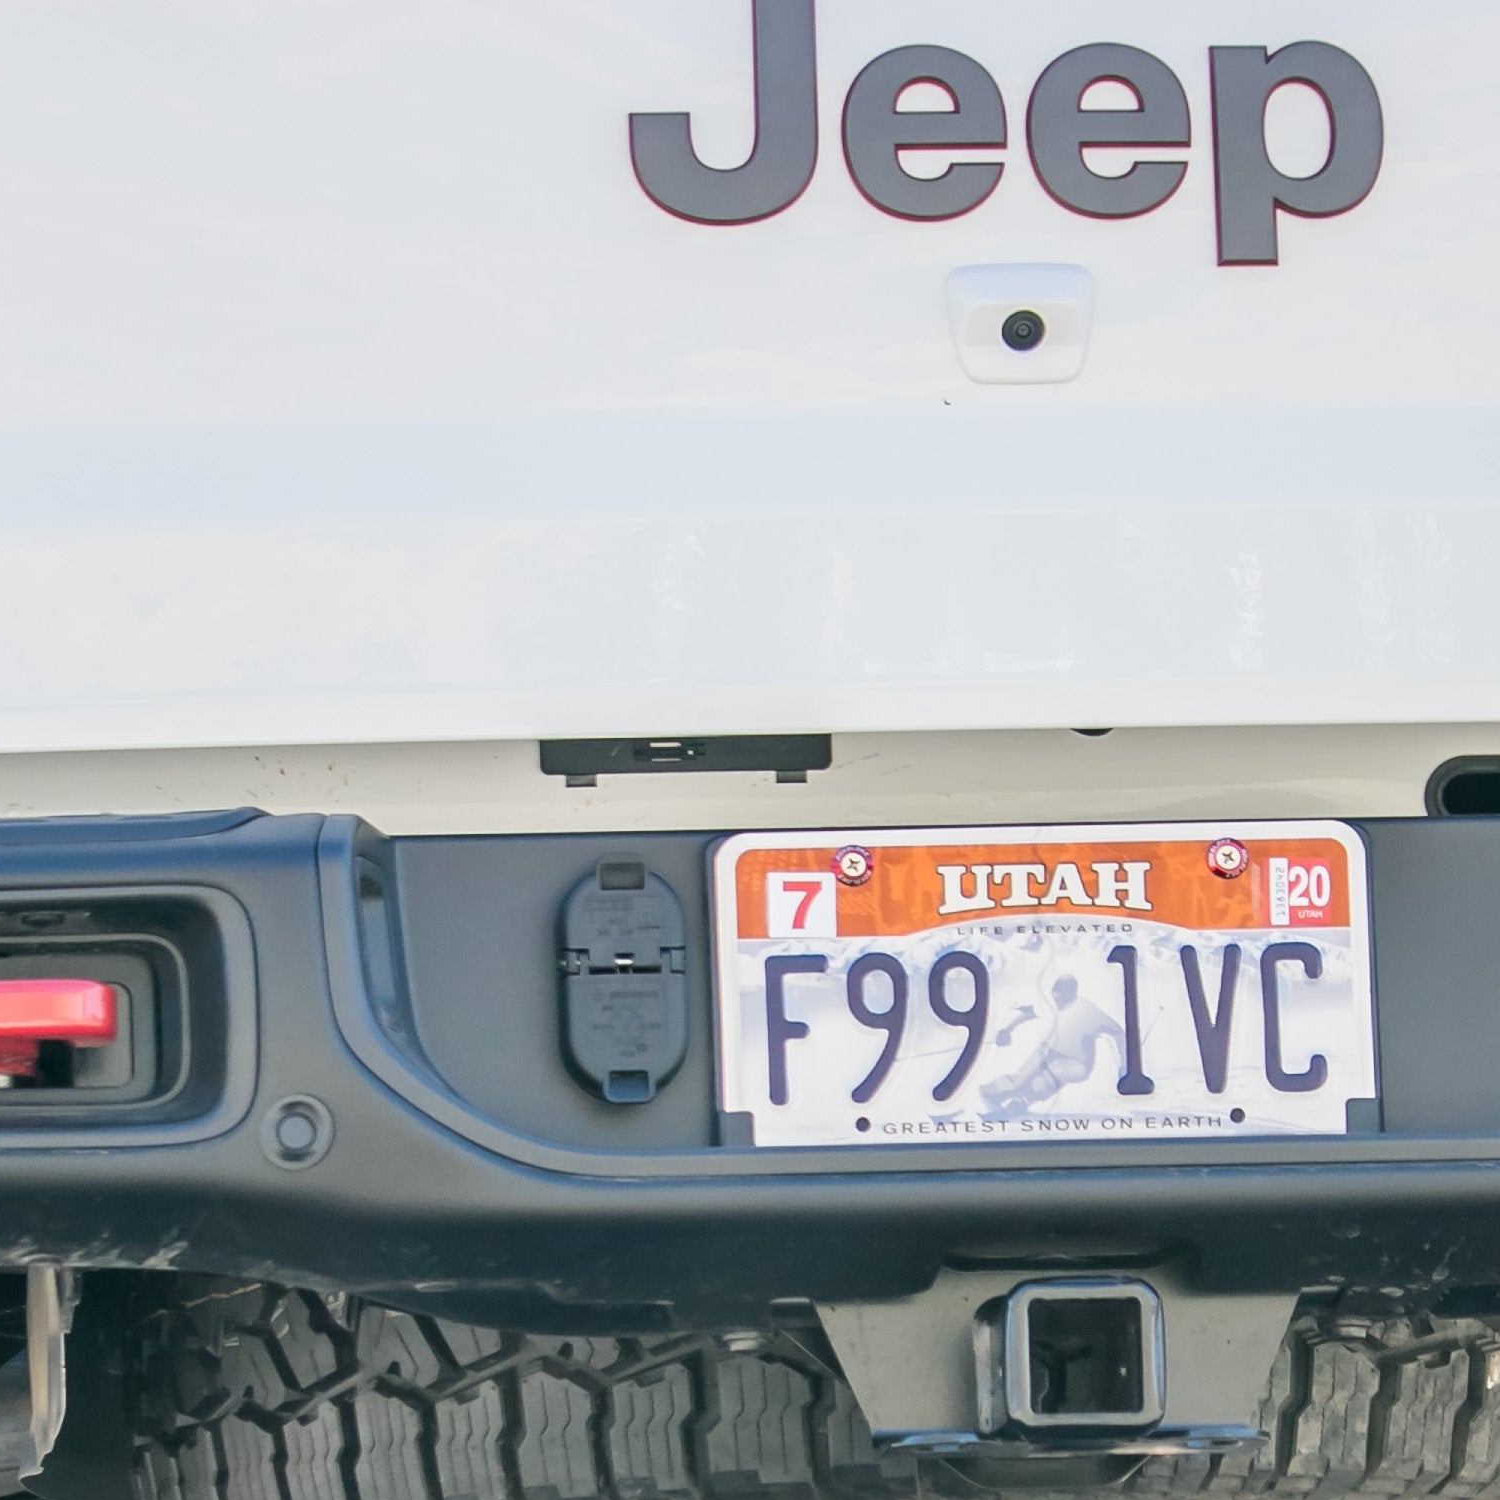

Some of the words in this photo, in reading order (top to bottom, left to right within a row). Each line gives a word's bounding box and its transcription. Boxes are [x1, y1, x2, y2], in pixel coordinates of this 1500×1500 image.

[628, 0, 1385, 267] Jeep
[782, 880, 824, 930] 7
[936, 860, 1153, 915] UTAH
[1288, 864, 1331, 907] 20
[957, 925, 1004, 936] LIFE
[1016, 923, 1134, 935] ELEVATED
[1297, 909, 1324, 919] UTAH
[763, 948, 991, 1106] F99
[1105, 940, 1328, 1096] 1VC
[882, 1120, 1009, 1134] GREATEST
[1021, 1118, 1090, 1132] SNOW
[1101, 1117, 1134, 1130] ON
[1145, 1115, 1222, 1129] EARTH
